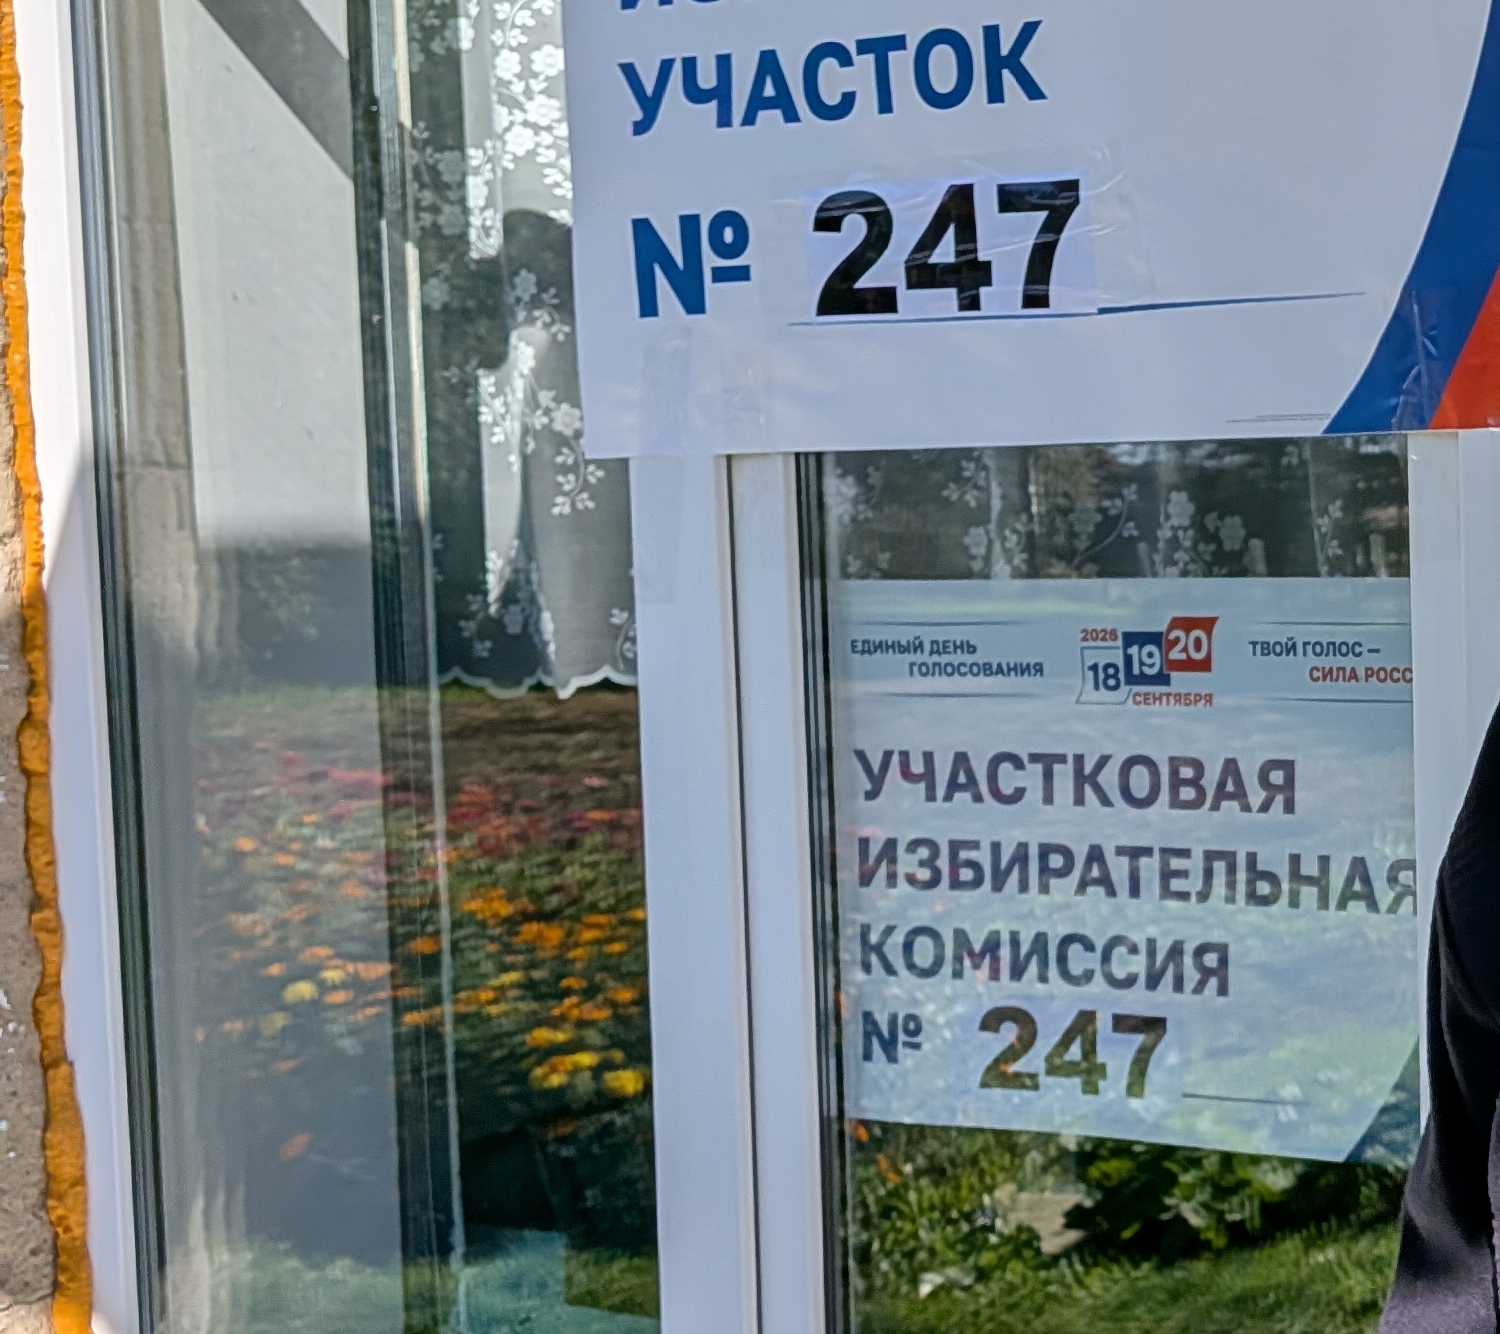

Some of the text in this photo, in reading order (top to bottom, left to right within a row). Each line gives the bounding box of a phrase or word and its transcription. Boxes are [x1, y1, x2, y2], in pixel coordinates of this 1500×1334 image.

[617, 20, 1048, 137] УЧАСТОК
[631, 178, 1082, 319] № 247
[850, 635, 978, 657] ЕДИНЫЙ ДЕНЬ
[1080, 629, 1118, 643] 2026
[1087, 629, 1208, 692] 18 19 20
[1249, 637, 1297, 658] ТВОЙ
[1302, 640, 1363, 658] ГОЛОС
[908, 661, 1045, 678] ГОЛОСОВАНИЯ
[1132, 692, 1214, 707] СЕНТЯБРЯ
[1308, 666, 1359, 683] СИЛА
[853, 748, 1297, 815] УЧАСТКОВАЯ
[857, 836, 1418, 917] ИЗБИРАТЕЛЬНАЯ
[859, 923, 1231, 998] КОМИССИЯ
[861, 1005, 1168, 1099] № 247
